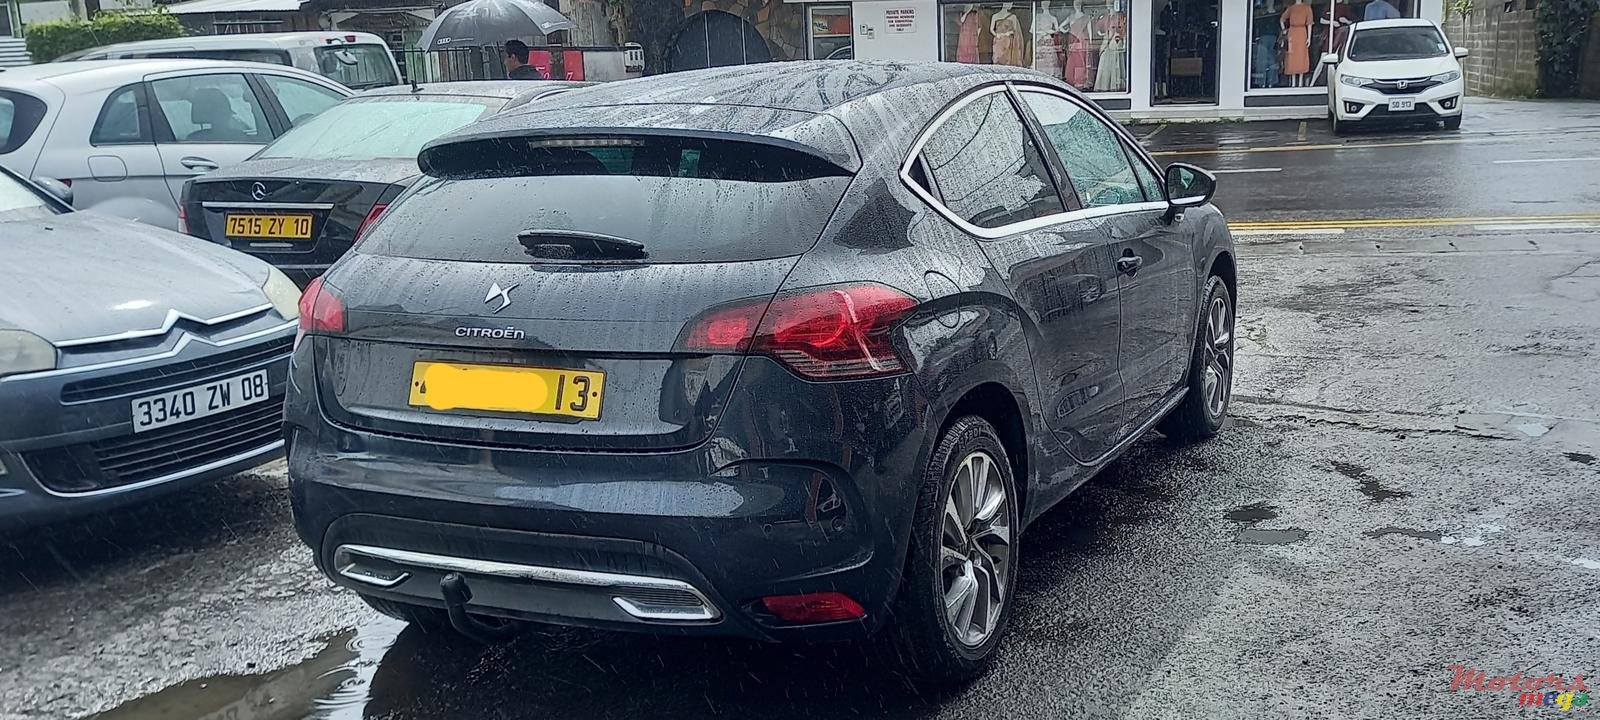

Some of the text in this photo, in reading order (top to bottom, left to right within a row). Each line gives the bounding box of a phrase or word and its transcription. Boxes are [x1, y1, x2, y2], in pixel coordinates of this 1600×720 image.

[230, 217, 309, 235] 7515 ZY 10
[138, 374, 264, 426] 3340 ZW 08
[555, 374, 591, 411] 13
